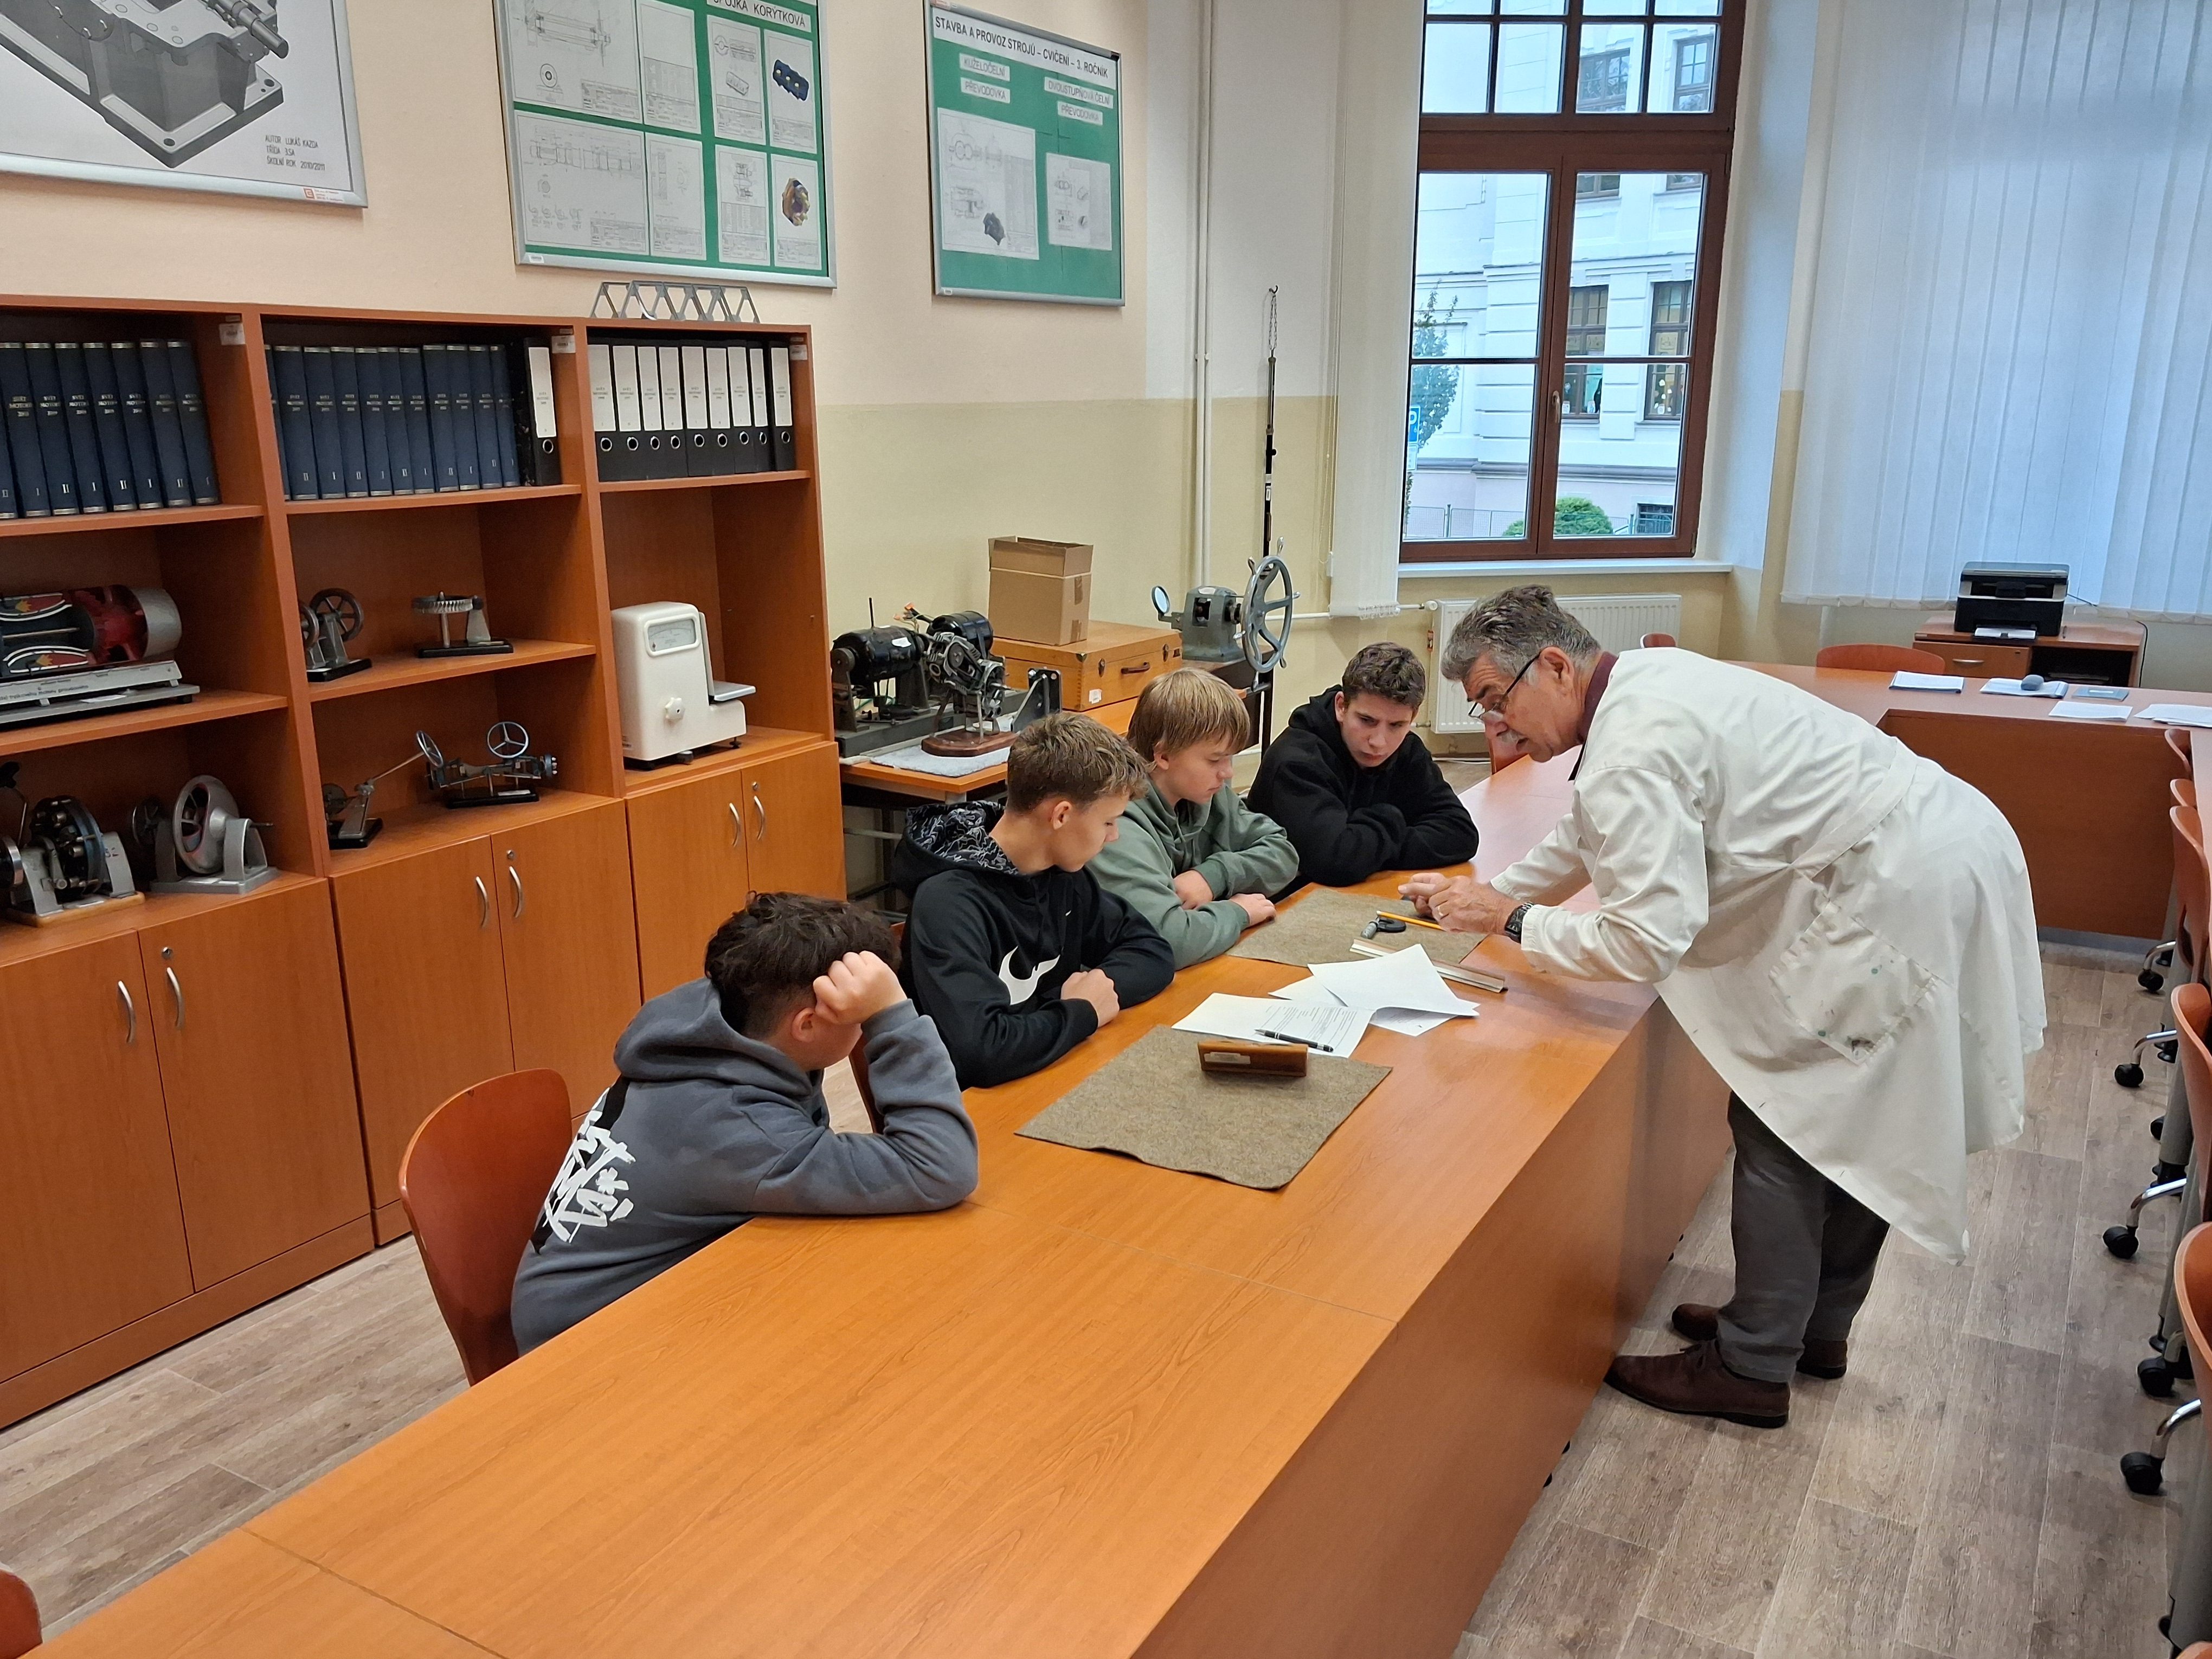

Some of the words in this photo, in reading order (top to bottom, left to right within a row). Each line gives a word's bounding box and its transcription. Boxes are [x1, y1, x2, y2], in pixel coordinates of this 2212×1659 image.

[754, 3, 805, 27] KORÝTKOVÁ
[935, 16, 967, 36] STAVBA
[969, 27, 975, 38] A
[976, 29, 1006, 48] PROVOZ
[1043, 49, 1069, 66] CVIČENÍ
[1077, 60, 1082, 70] 3.
[1084, 62, 1108, 78] ROČNÍK
[965, 80, 1006, 100] PŘEVODOVKA
[1061, 104, 1099, 121] PŘEVODOVKA
[285, 137, 301, 147] LUKÁŠ
[62, 484, 70, 494] II
[119, 480, 127, 490] II
